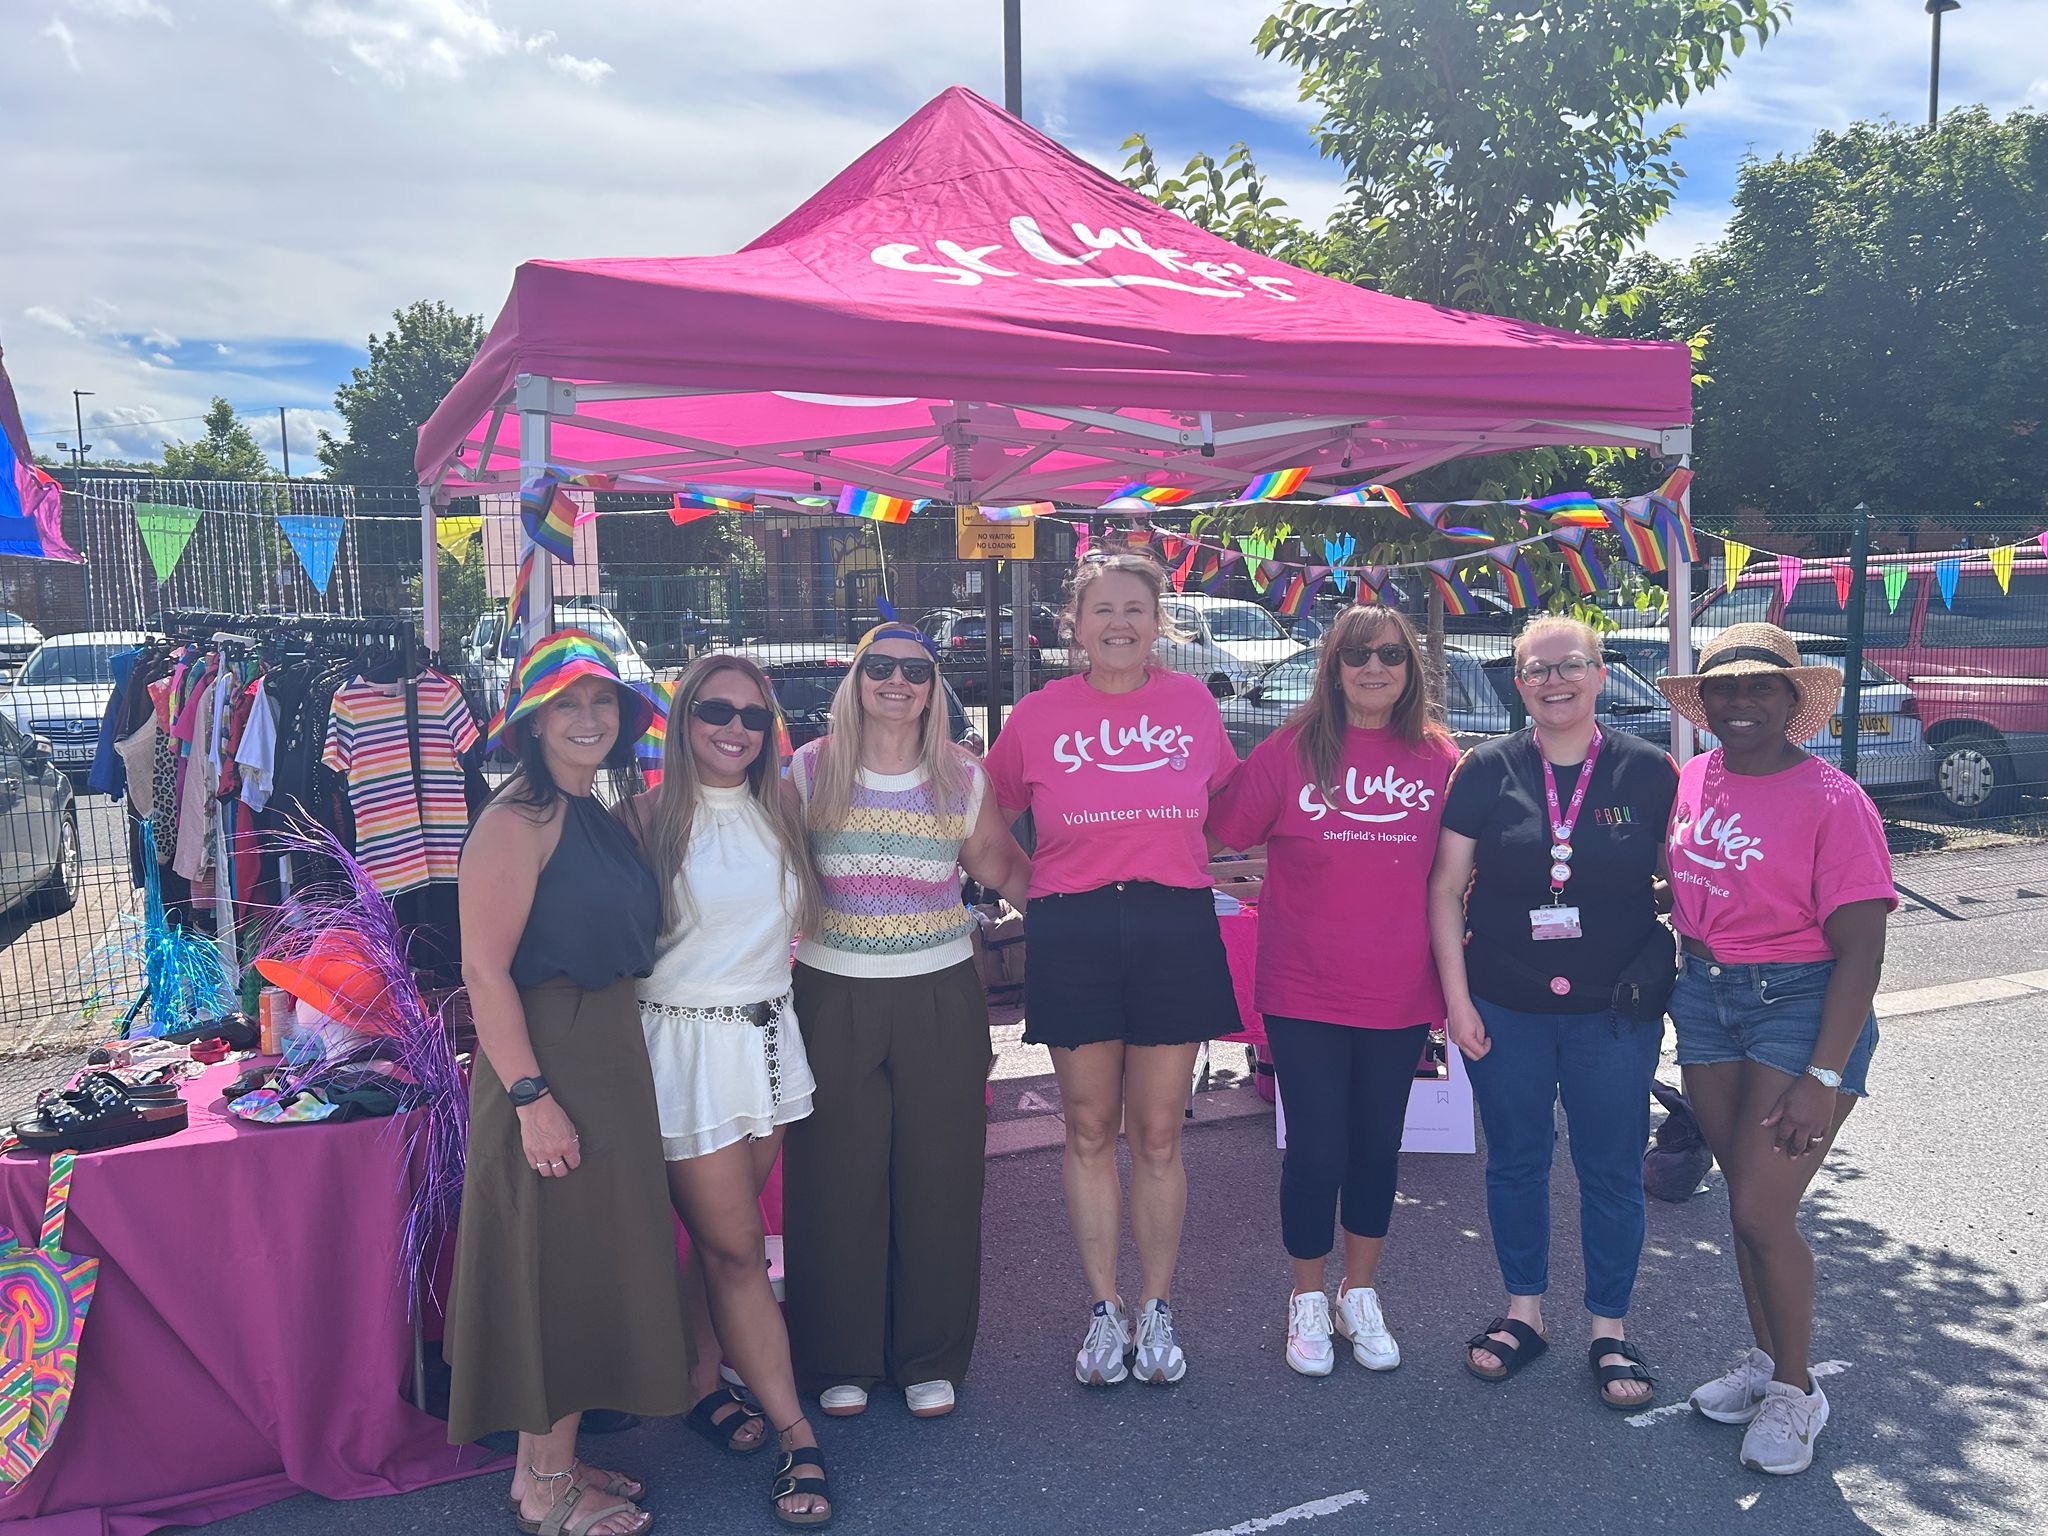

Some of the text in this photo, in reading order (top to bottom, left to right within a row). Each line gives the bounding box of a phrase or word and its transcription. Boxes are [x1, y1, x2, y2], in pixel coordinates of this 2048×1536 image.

[870, 216, 1297, 301] St Luke's
[1053, 714, 1194, 774] St Luke's
[1345, 765, 1435, 811] Luke's
[1062, 805, 1200, 826] Volunteer with us
[1323, 830, 1418, 844] Sheffield's Hospice
